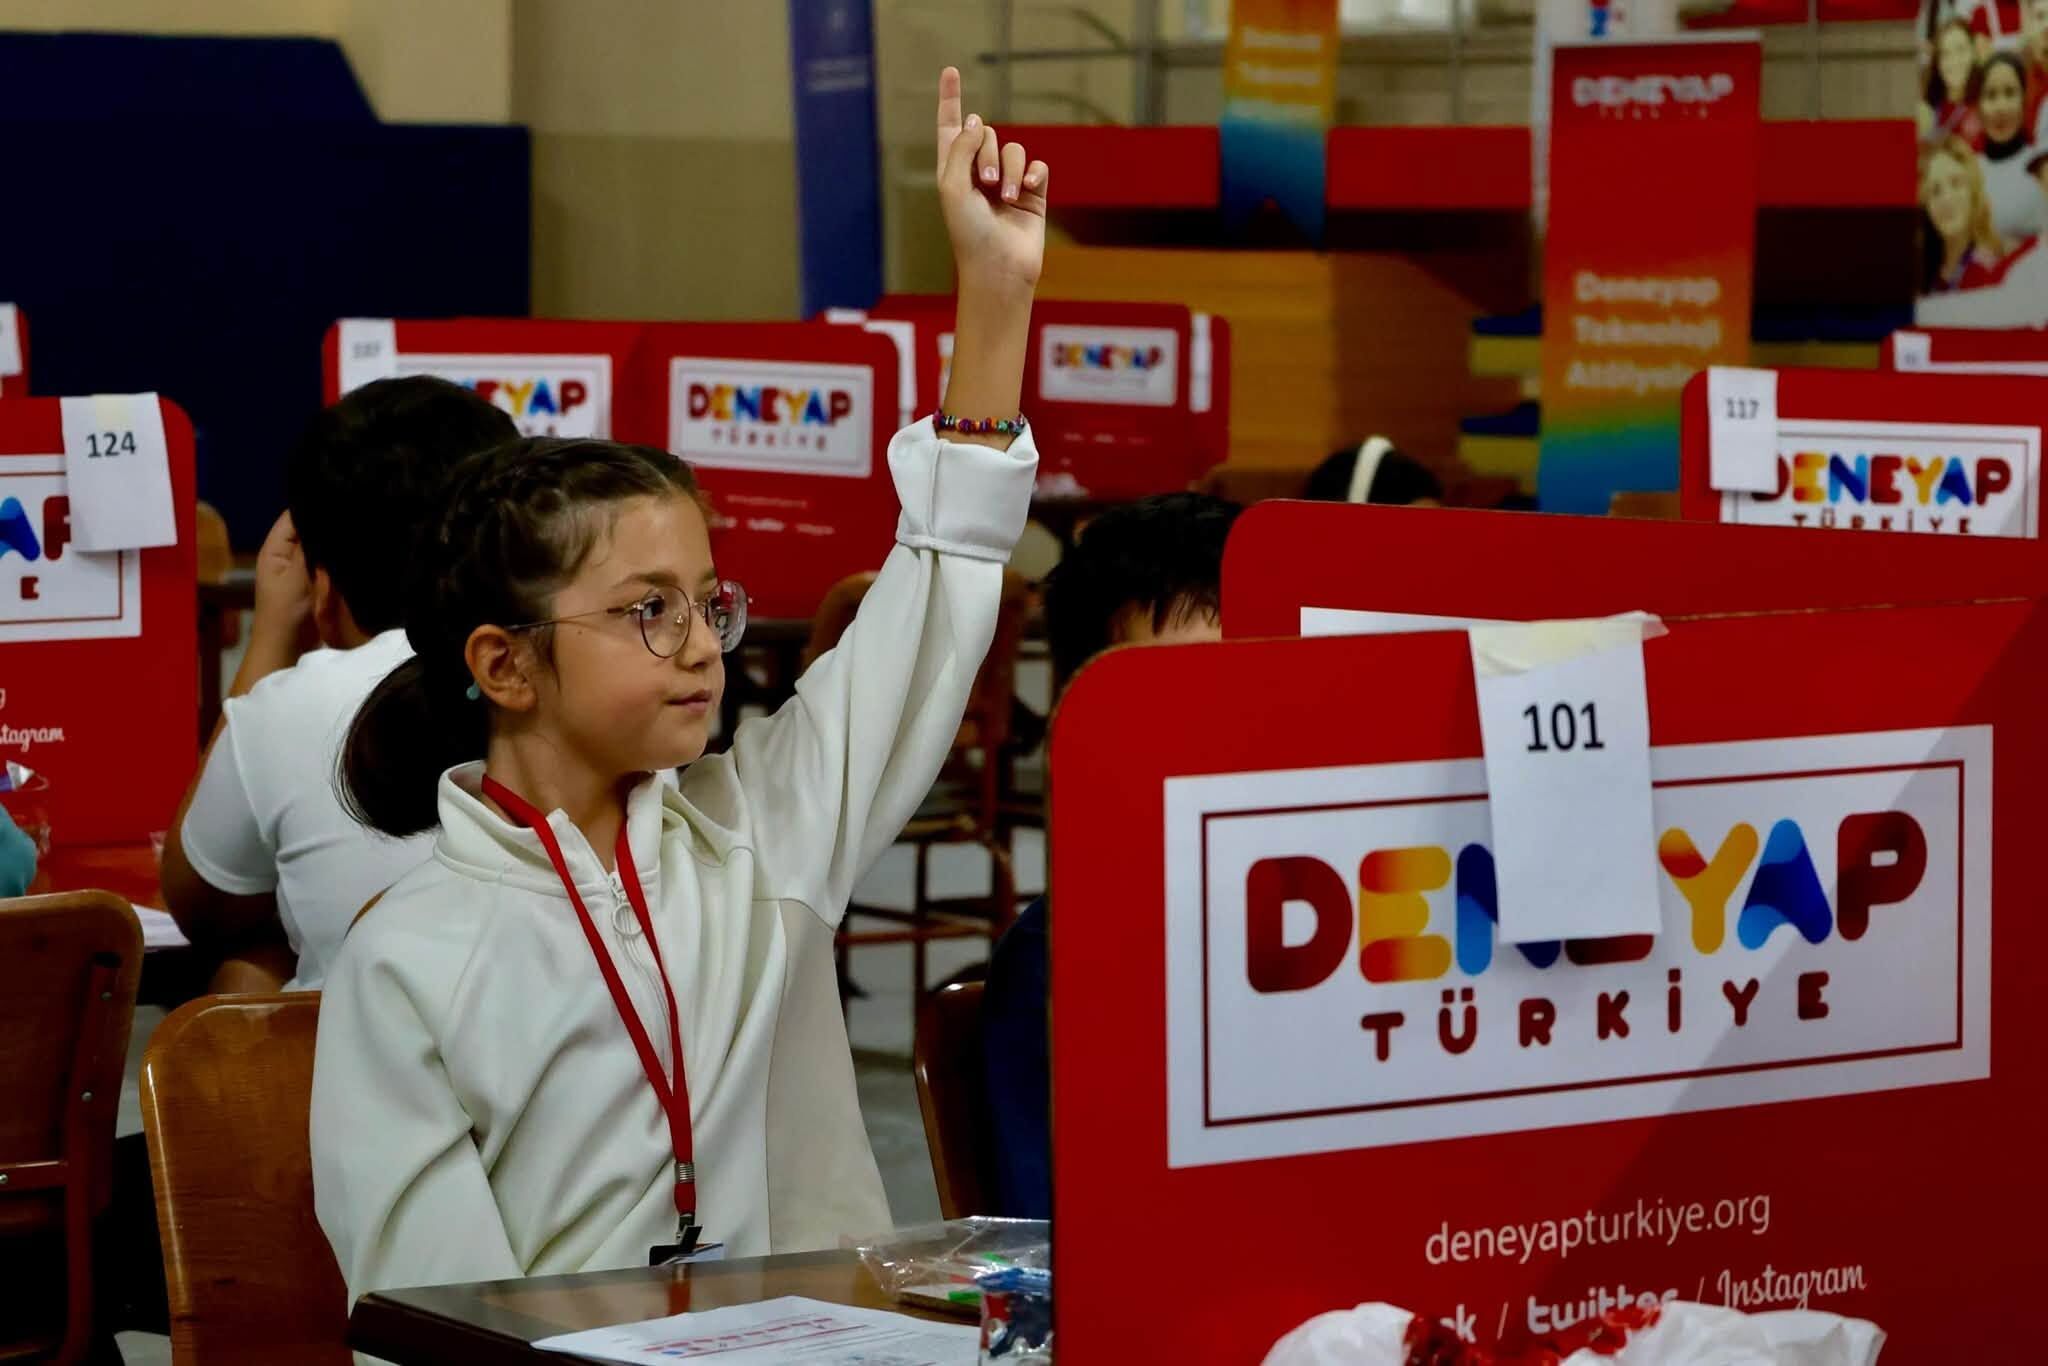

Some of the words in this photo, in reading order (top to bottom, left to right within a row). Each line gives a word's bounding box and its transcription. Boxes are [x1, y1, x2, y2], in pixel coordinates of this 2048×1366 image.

[689, 384, 852, 427] DENEYAP
[1725, 397, 1760, 420] 117
[86, 430, 137, 458] 124
[0, 723, 65, 753] tagram
[1523, 701, 1606, 752] 101
[1246, 810, 1929, 994] DENYAP
[1361, 968, 1831, 1063] TÜRKİYE
[1425, 1194, 1771, 1265] deneyapturkiye.org
[1717, 1263, 1867, 1312] Instagram
